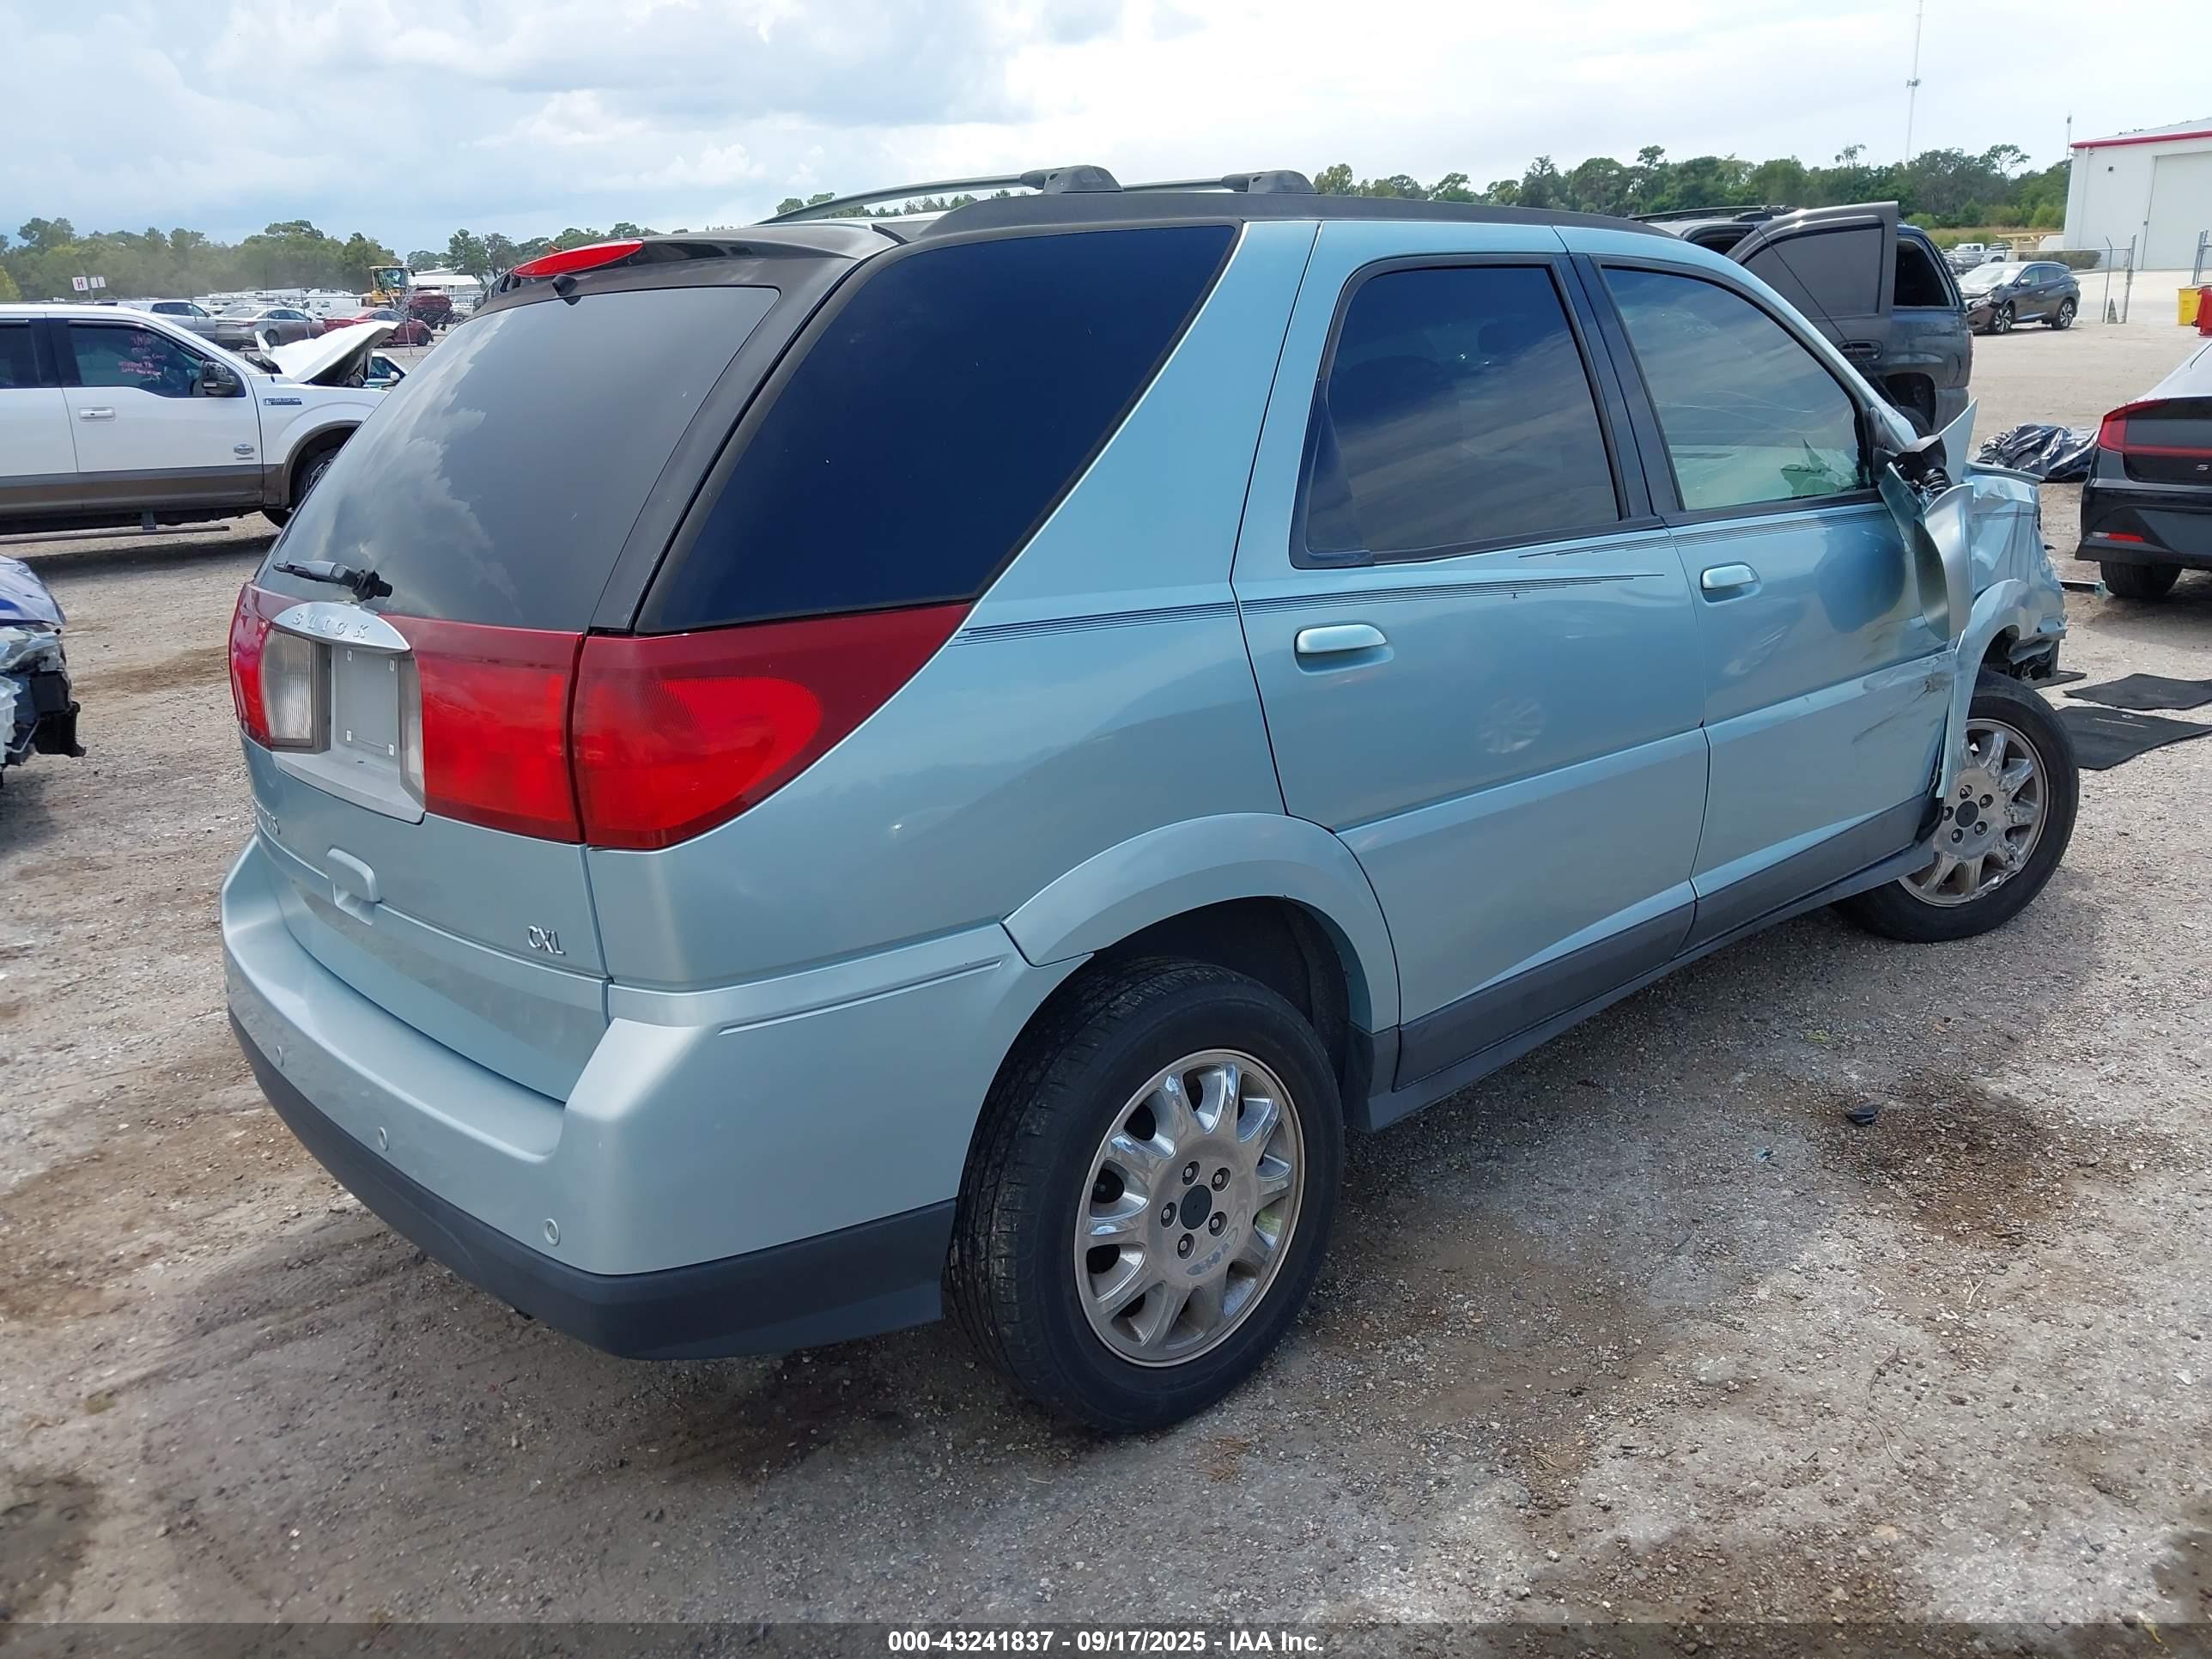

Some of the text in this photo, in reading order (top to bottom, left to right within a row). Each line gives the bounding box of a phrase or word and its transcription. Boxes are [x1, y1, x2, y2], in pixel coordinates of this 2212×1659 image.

[76, 277, 85, 289] H
[292, 611, 369, 639] BUICK
[527, 925, 566, 956] CXL
